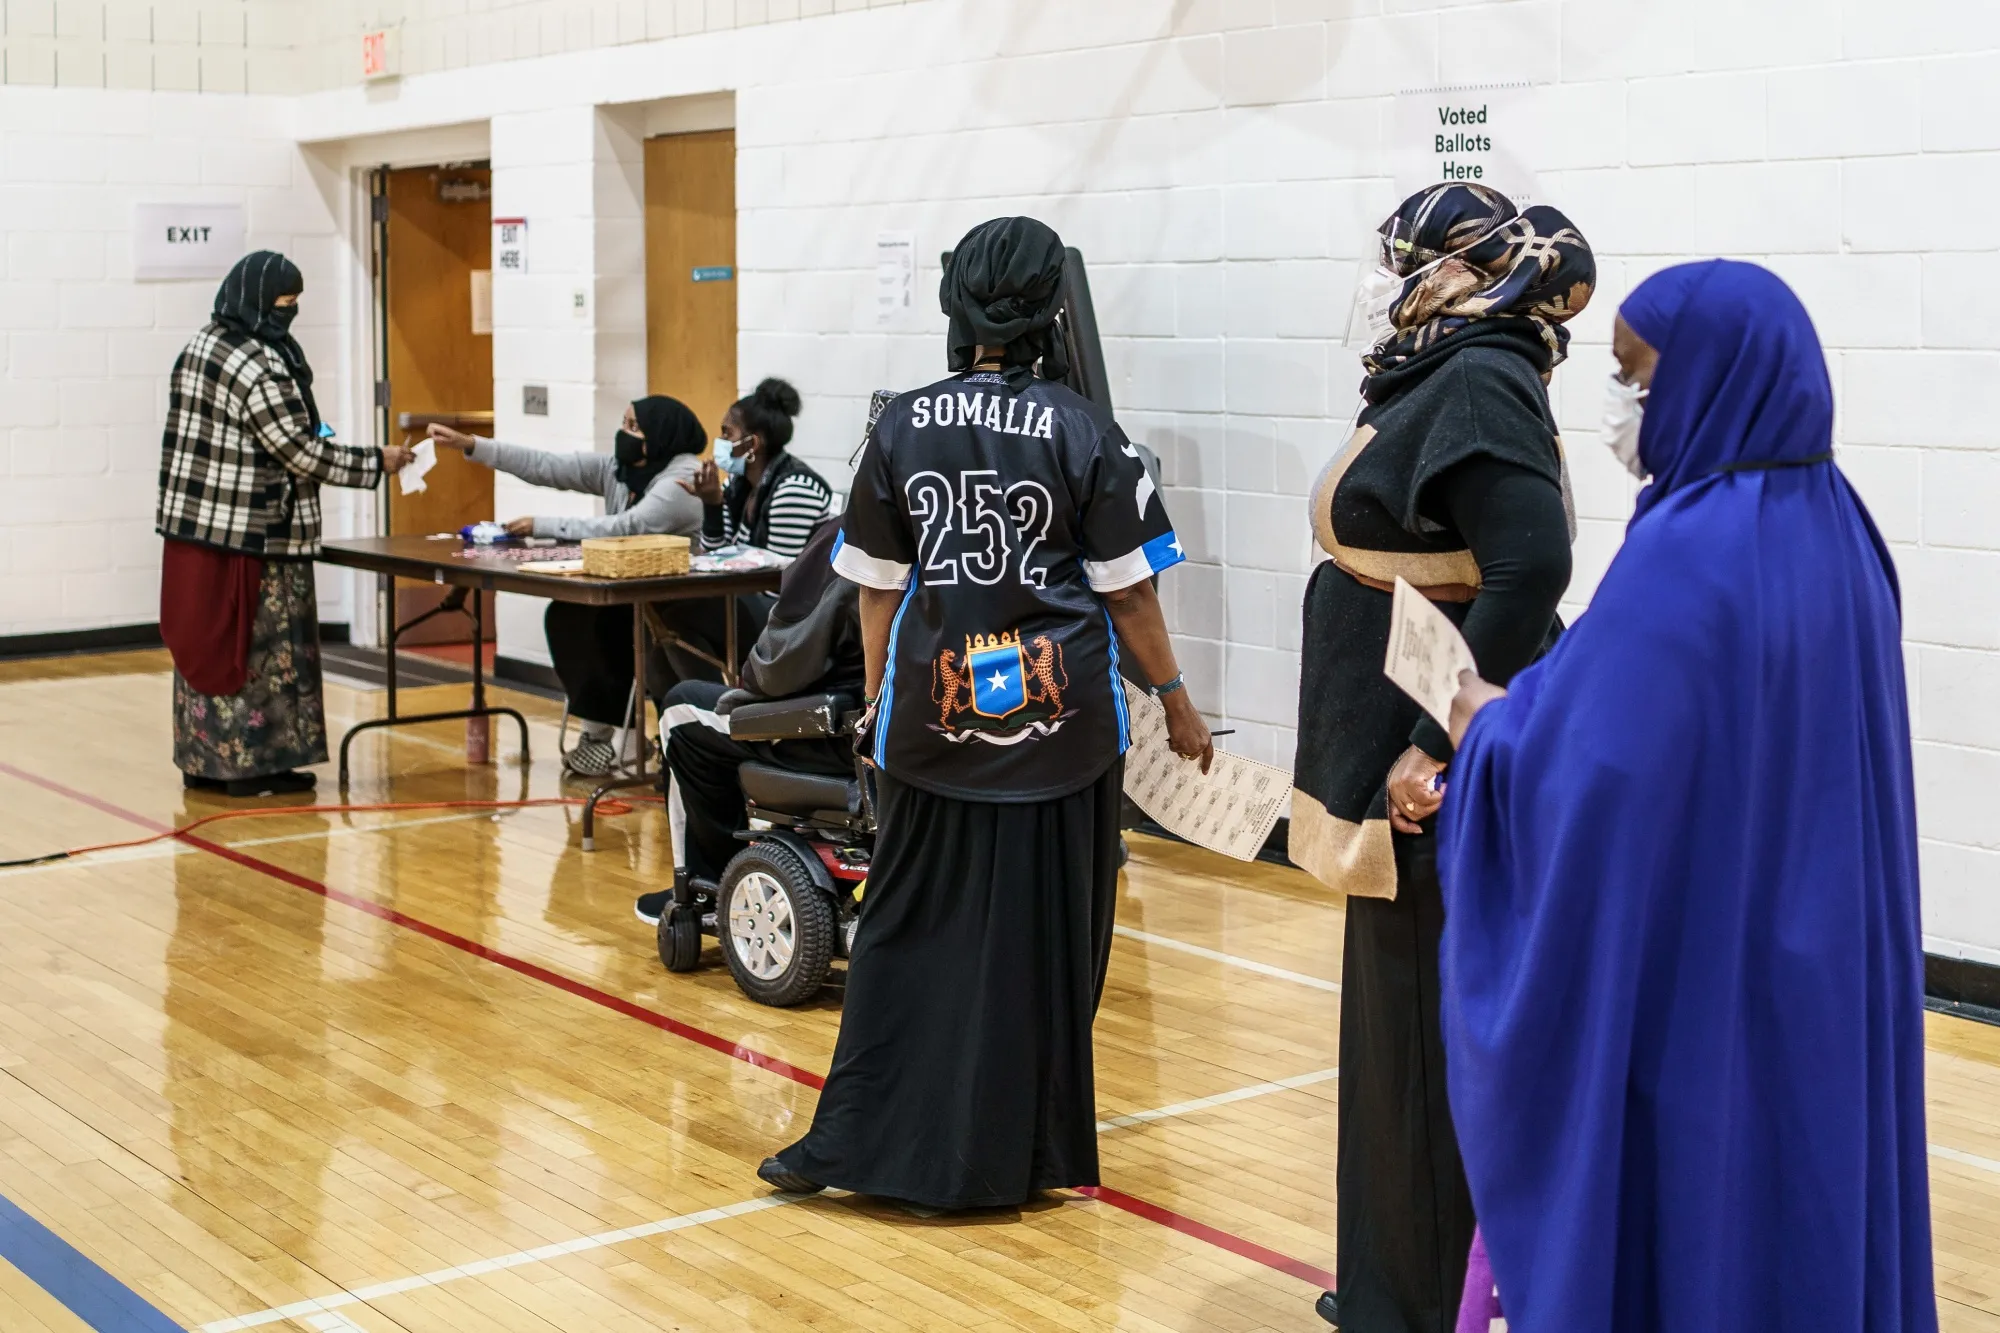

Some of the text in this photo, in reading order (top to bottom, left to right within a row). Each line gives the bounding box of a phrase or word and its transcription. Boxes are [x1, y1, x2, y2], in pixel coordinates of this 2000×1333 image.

[1438, 104, 1487, 125] Voted
[1435, 133, 1491, 153] Ballots
[1443, 161, 1483, 180] Here
[166, 226, 212, 243] EXIT
[911, 392, 1055, 439] SOMALIA
[904, 470, 1053, 590] 252
